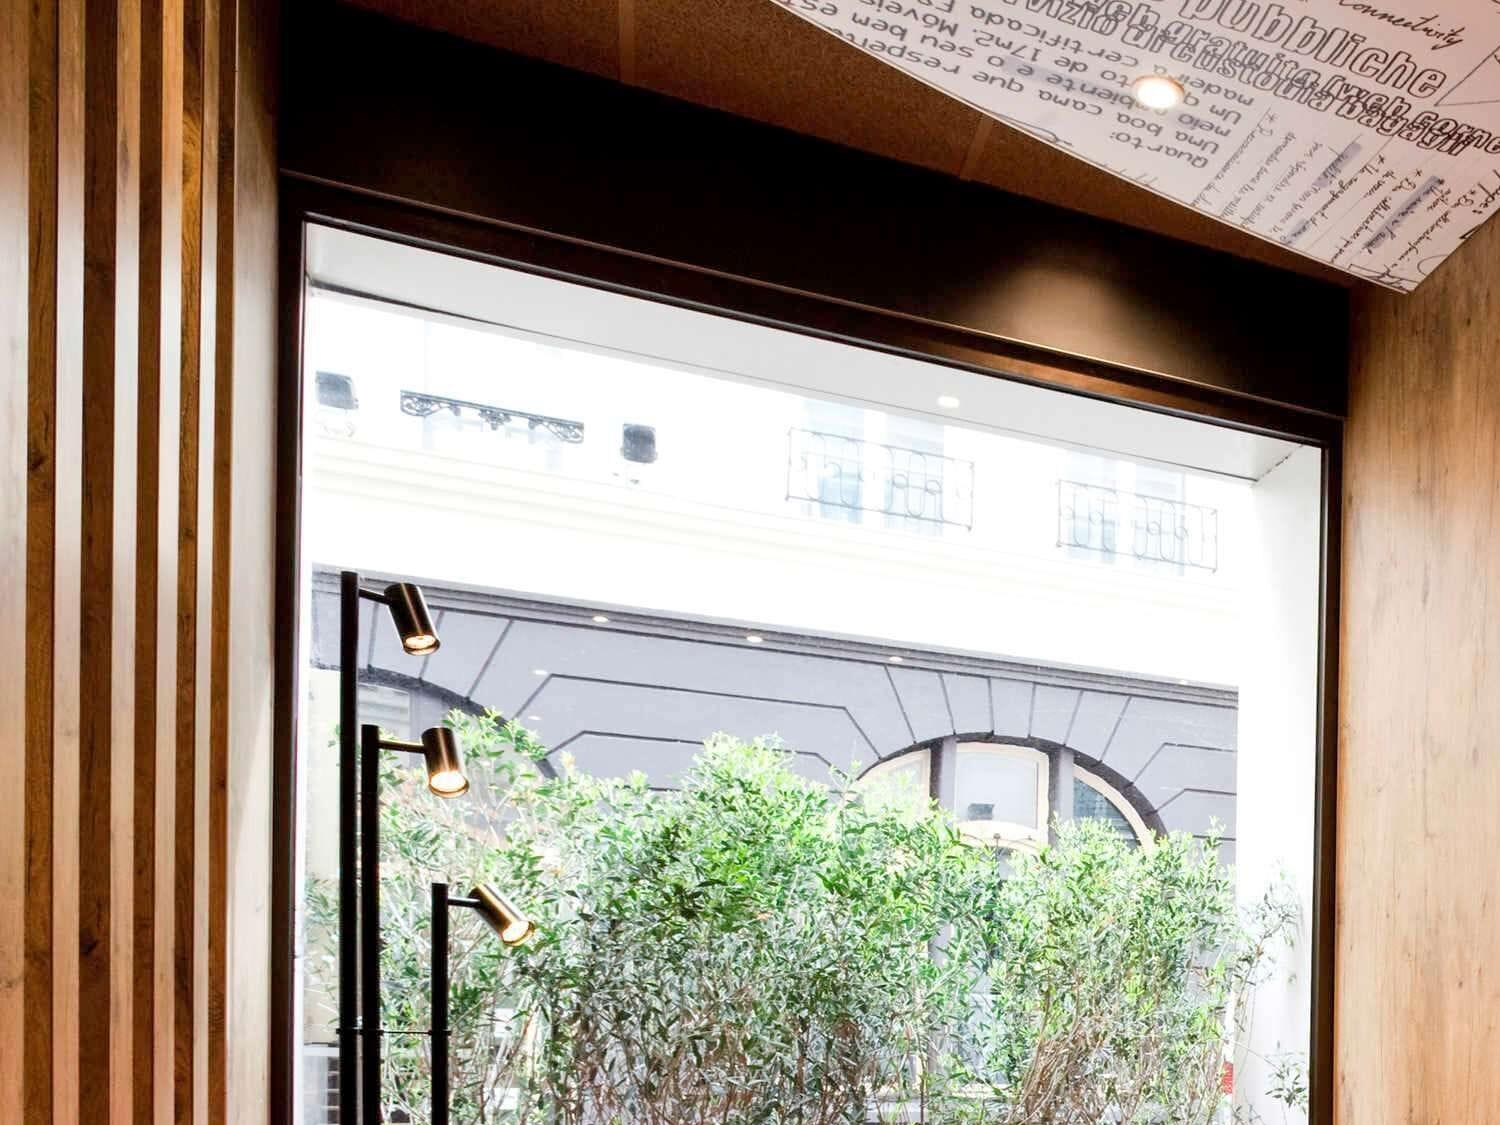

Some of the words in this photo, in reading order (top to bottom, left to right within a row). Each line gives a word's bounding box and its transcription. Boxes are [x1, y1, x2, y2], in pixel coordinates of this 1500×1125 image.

[851, 12, 908, 41] bem
[970, 5, 1139, 69] certificada
[920, 34, 975, 59] seu
[971, 29, 1042, 62] 17m2.
[986, 54, 1005, 68] o
[1016, 64, 1035, 78] e
[1053, 56, 1089, 75] de
[971, 72, 1025, 94] que
[1038, 89, 1103, 117] cama
[1209, 103, 1242, 126] Um
[1116, 113, 1163, 138] boa
[1178, 113, 1231, 138] meio
[1109, 131, 1209, 169] Quarto:
[1175, 130, 1220, 155] Uma
